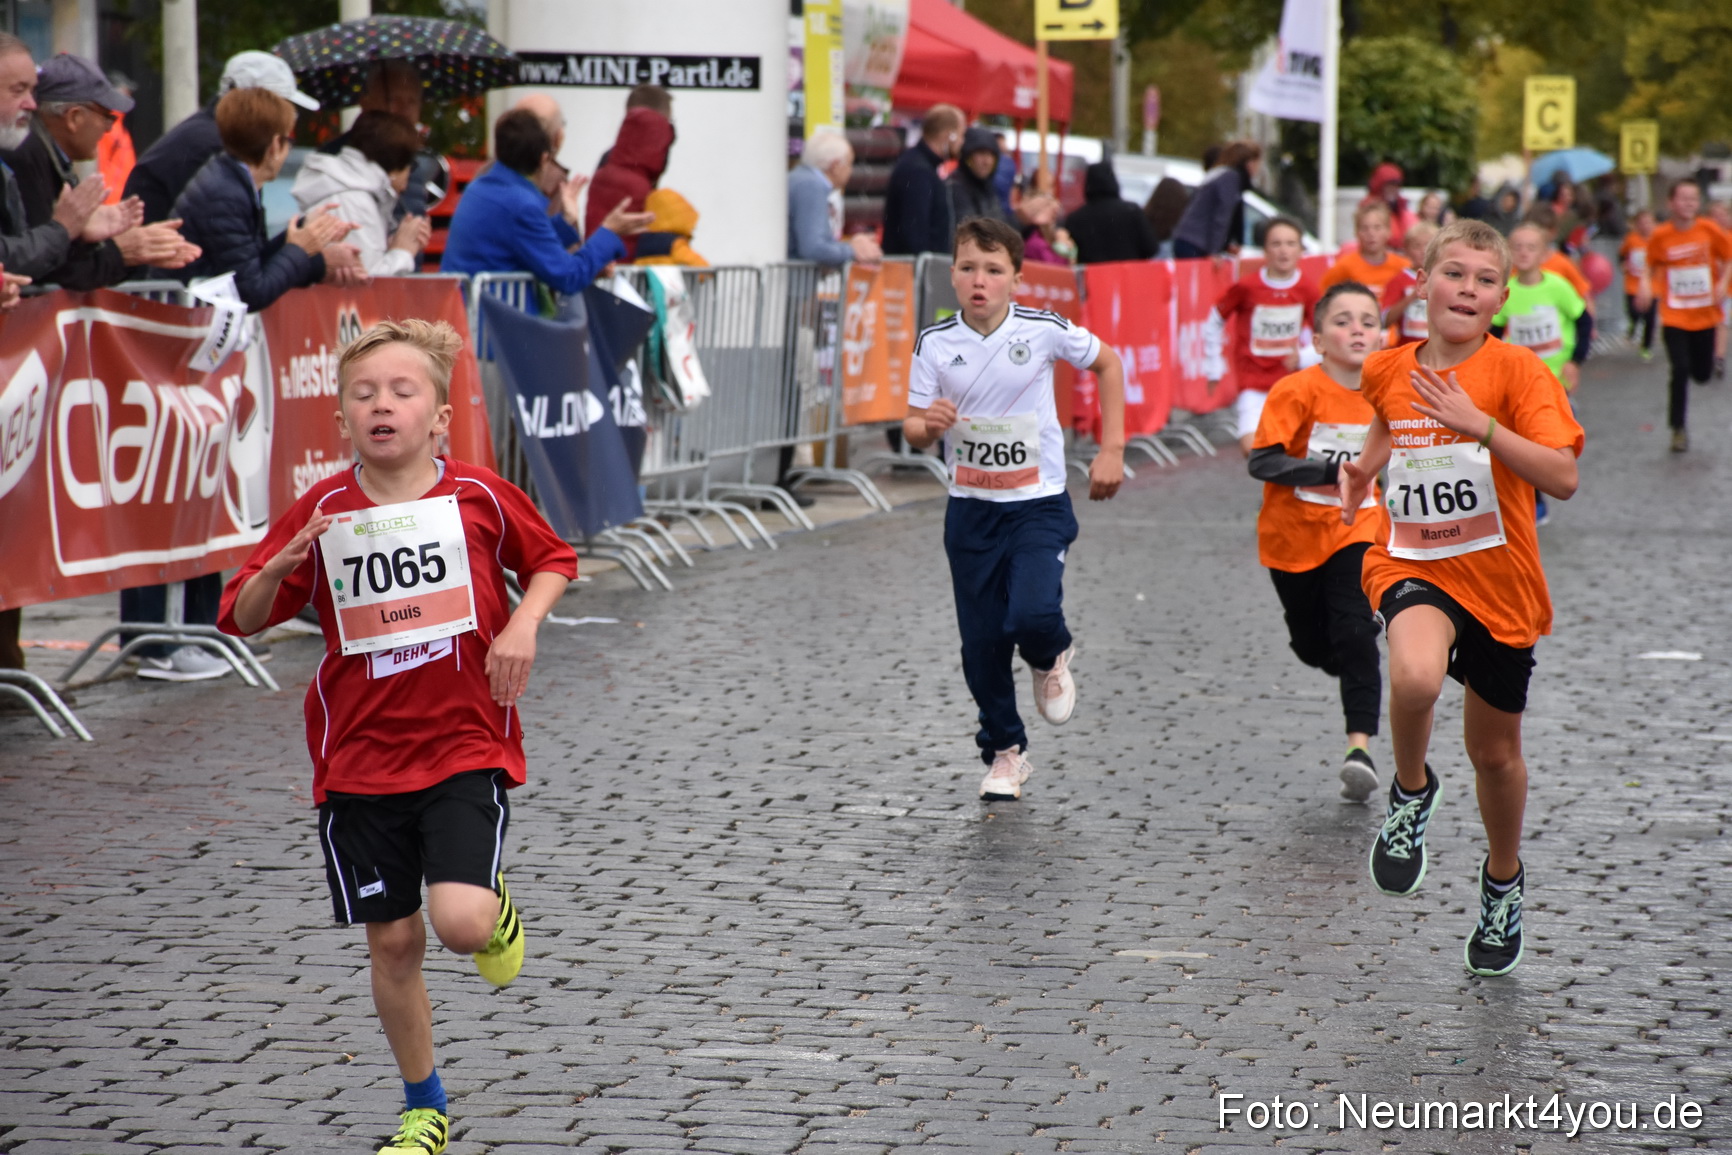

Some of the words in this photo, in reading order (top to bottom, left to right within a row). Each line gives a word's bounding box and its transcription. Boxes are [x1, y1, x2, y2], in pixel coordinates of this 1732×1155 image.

[1537, 99, 1561, 134] C
[1389, 416, 1446, 430] eumarkt
[963, 441, 1026, 466] 7266
[967, 473, 1005, 487] LUIS
[1399, 479, 1478, 516] 7166
[366, 515, 417, 534] BOCK
[1421, 525, 1461, 541] Marcel
[343, 541, 447, 597] 7065
[1395, 585, 1428, 599] adidas
[381, 605, 421, 624] Louis
[393, 643, 429, 665] DEHN
